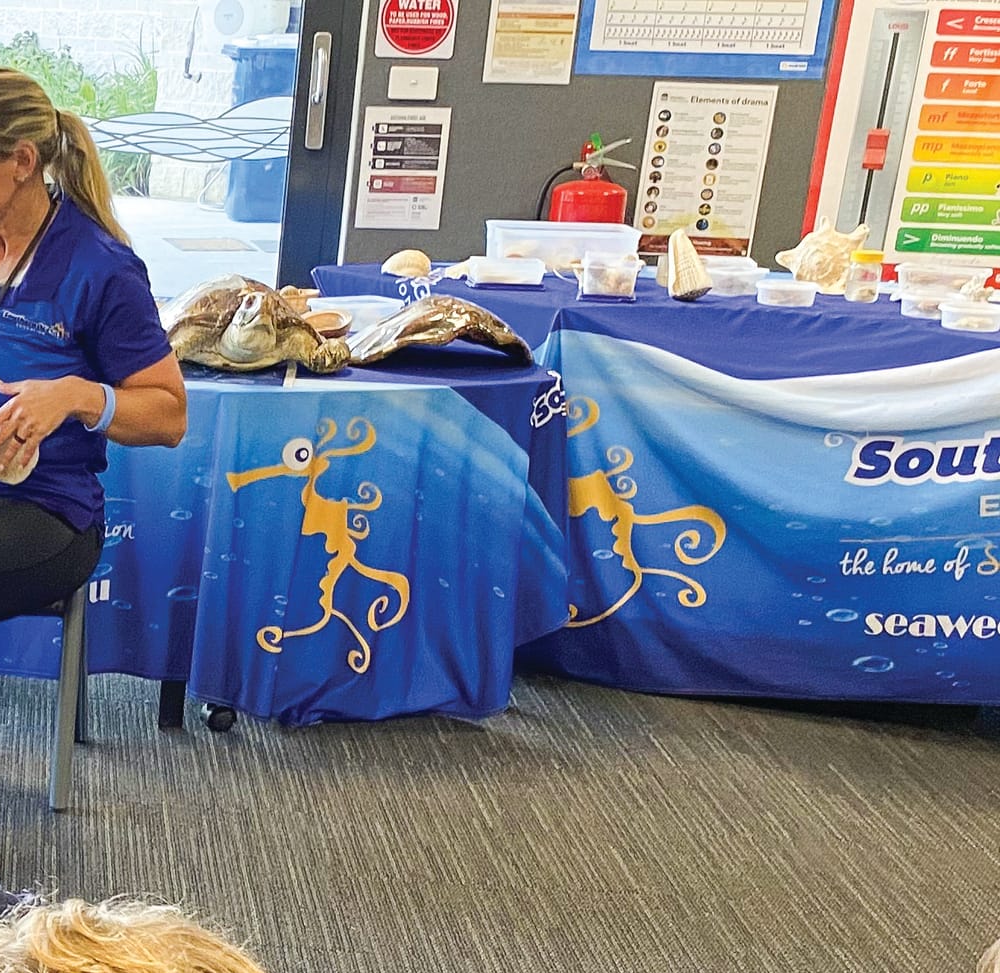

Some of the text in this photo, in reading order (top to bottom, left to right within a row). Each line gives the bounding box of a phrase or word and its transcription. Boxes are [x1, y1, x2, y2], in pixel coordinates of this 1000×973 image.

[398, 0, 441, 10] WATER
[963, 79, 987, 89] Forte
[691, 95, 730, 105] Elements
[731, 97, 740, 105] of
[741, 97, 769, 106] drama
[945, 172, 969, 181] Piano
[910, 203, 930, 216] pp
[931, 233, 984, 244] Diminuendo
[839, 547, 876, 576] the
[882, 547, 937, 575] home
[943, 545, 971, 581] of
[864, 612, 1000, 639] seawe
